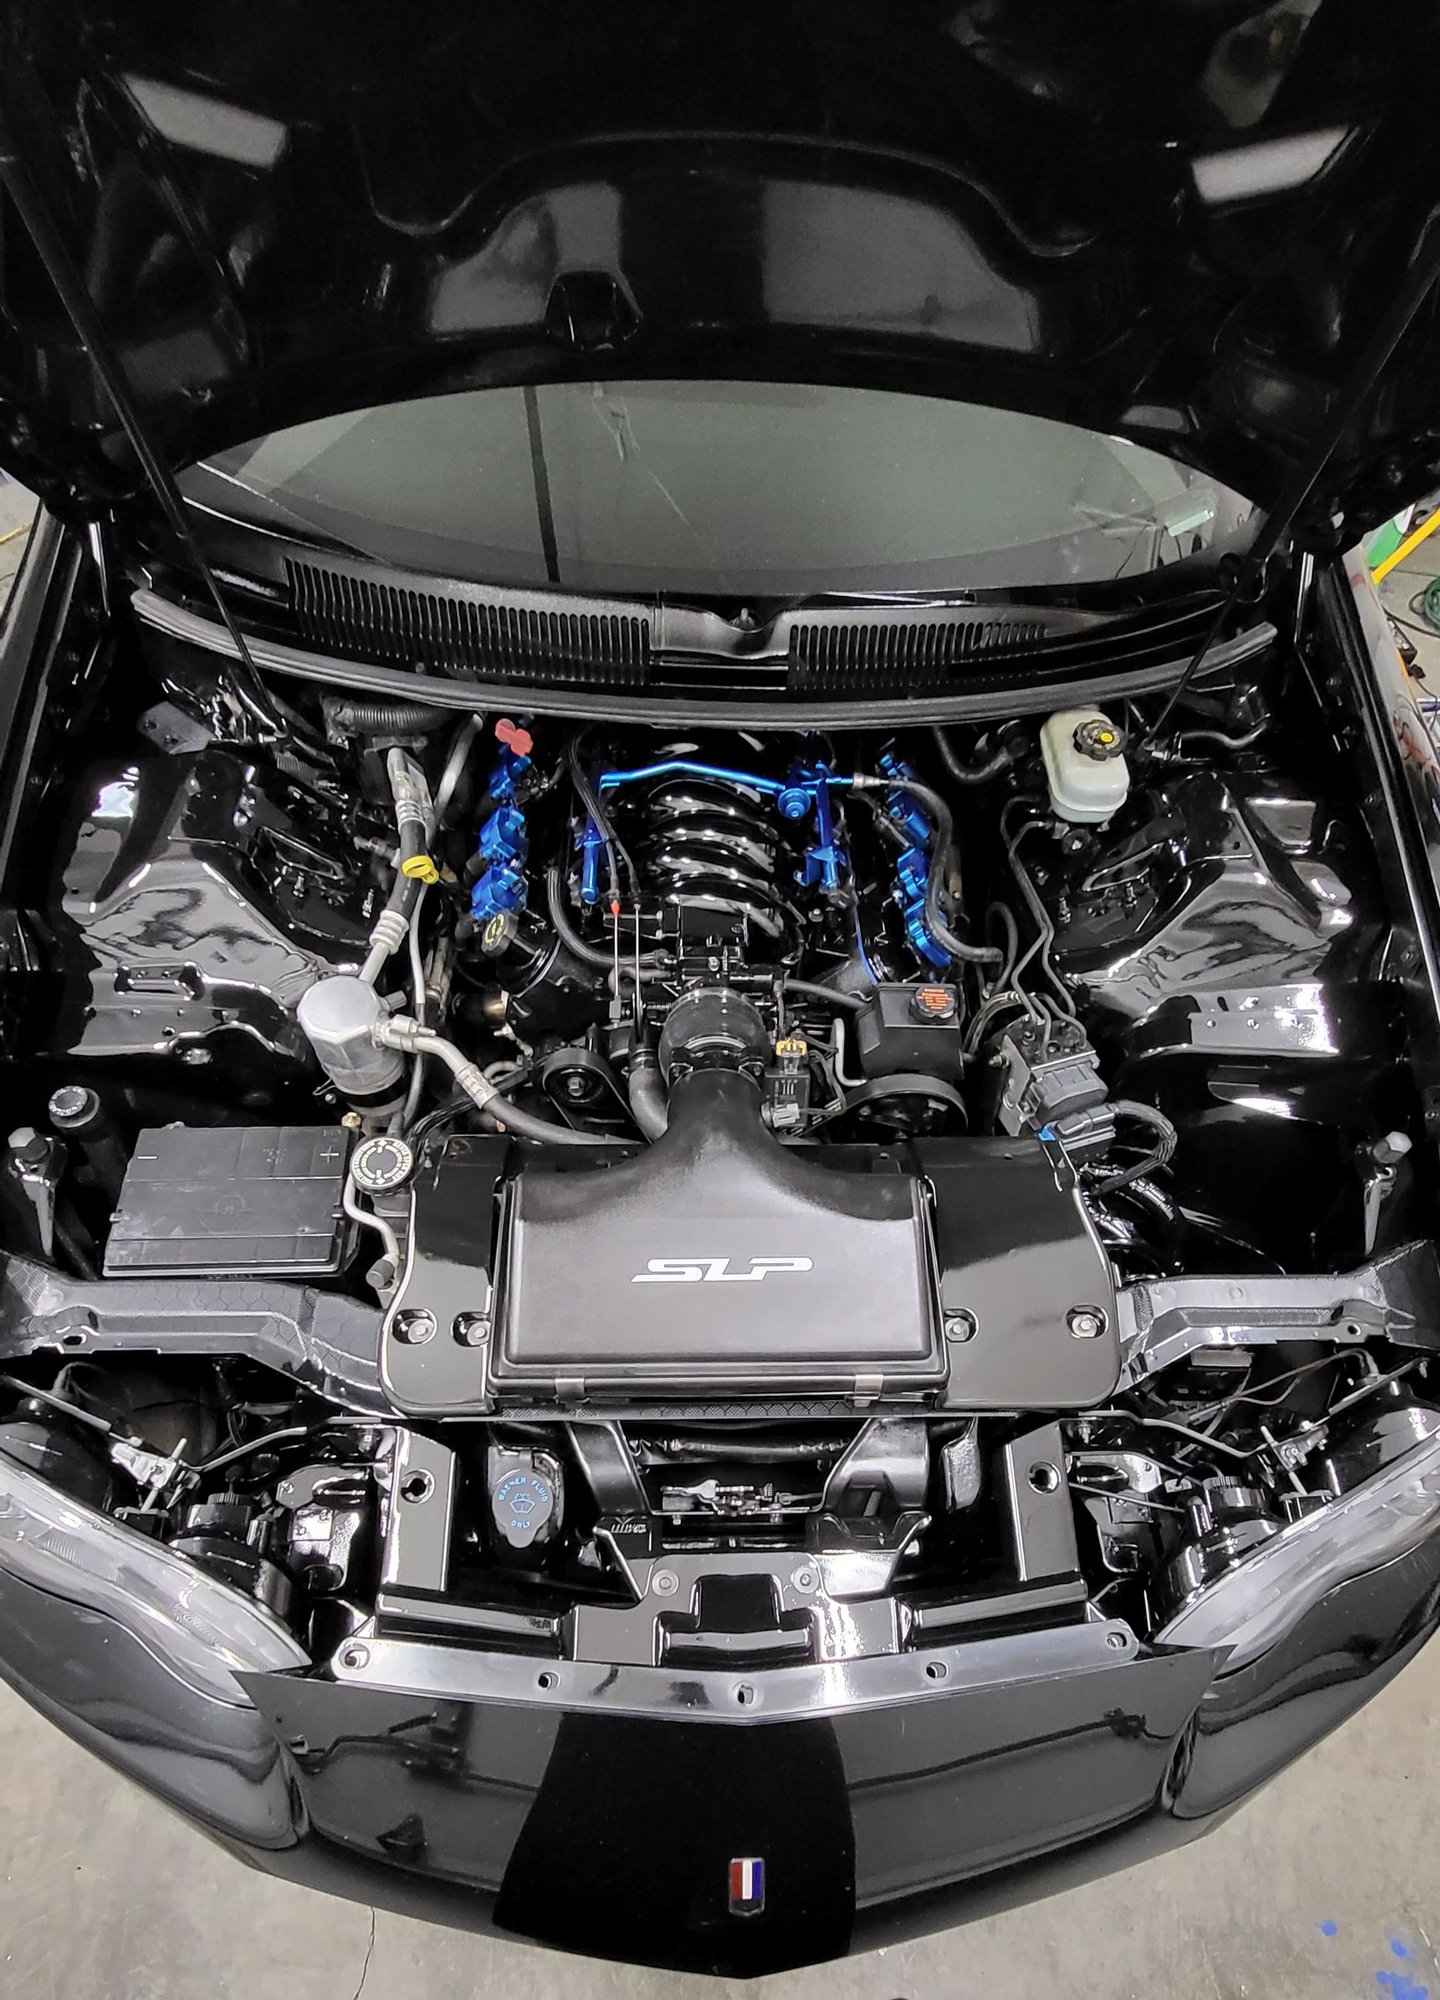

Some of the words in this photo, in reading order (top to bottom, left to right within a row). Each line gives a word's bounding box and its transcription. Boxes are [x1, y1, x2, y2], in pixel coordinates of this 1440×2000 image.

[631, 1256, 814, 1283] SLP
[498, 1477, 526, 1501] WASHER
[531, 1480, 548, 1502] FLUID
[511, 1520, 531, 1529] ONLY
